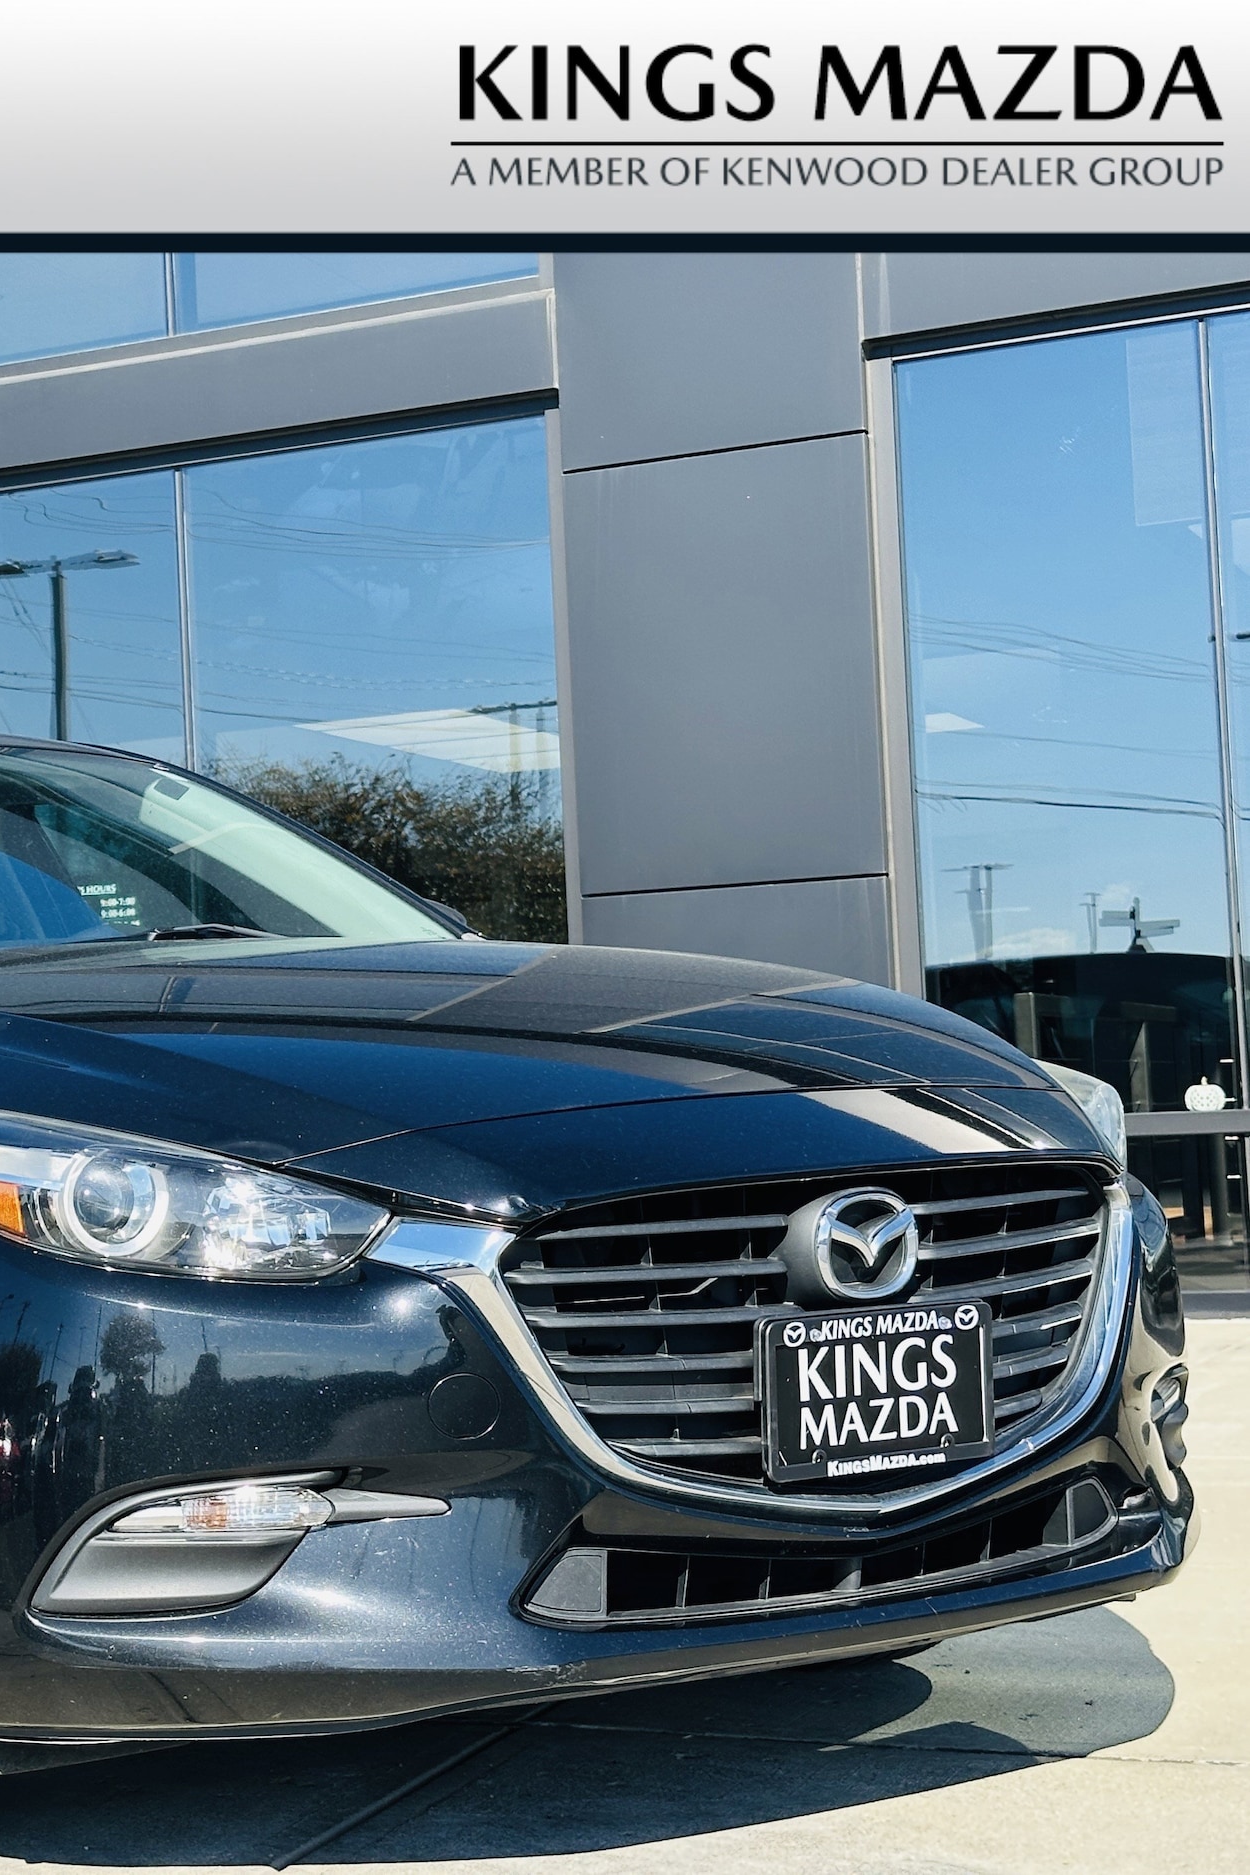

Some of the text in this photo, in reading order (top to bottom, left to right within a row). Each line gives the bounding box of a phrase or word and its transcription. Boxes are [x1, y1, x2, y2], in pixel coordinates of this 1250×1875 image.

[821, 1310, 939, 1342] KINGS MAZDA
[798, 1334, 957, 1402] KINGS
[800, 1392, 959, 1450] MAZDA
